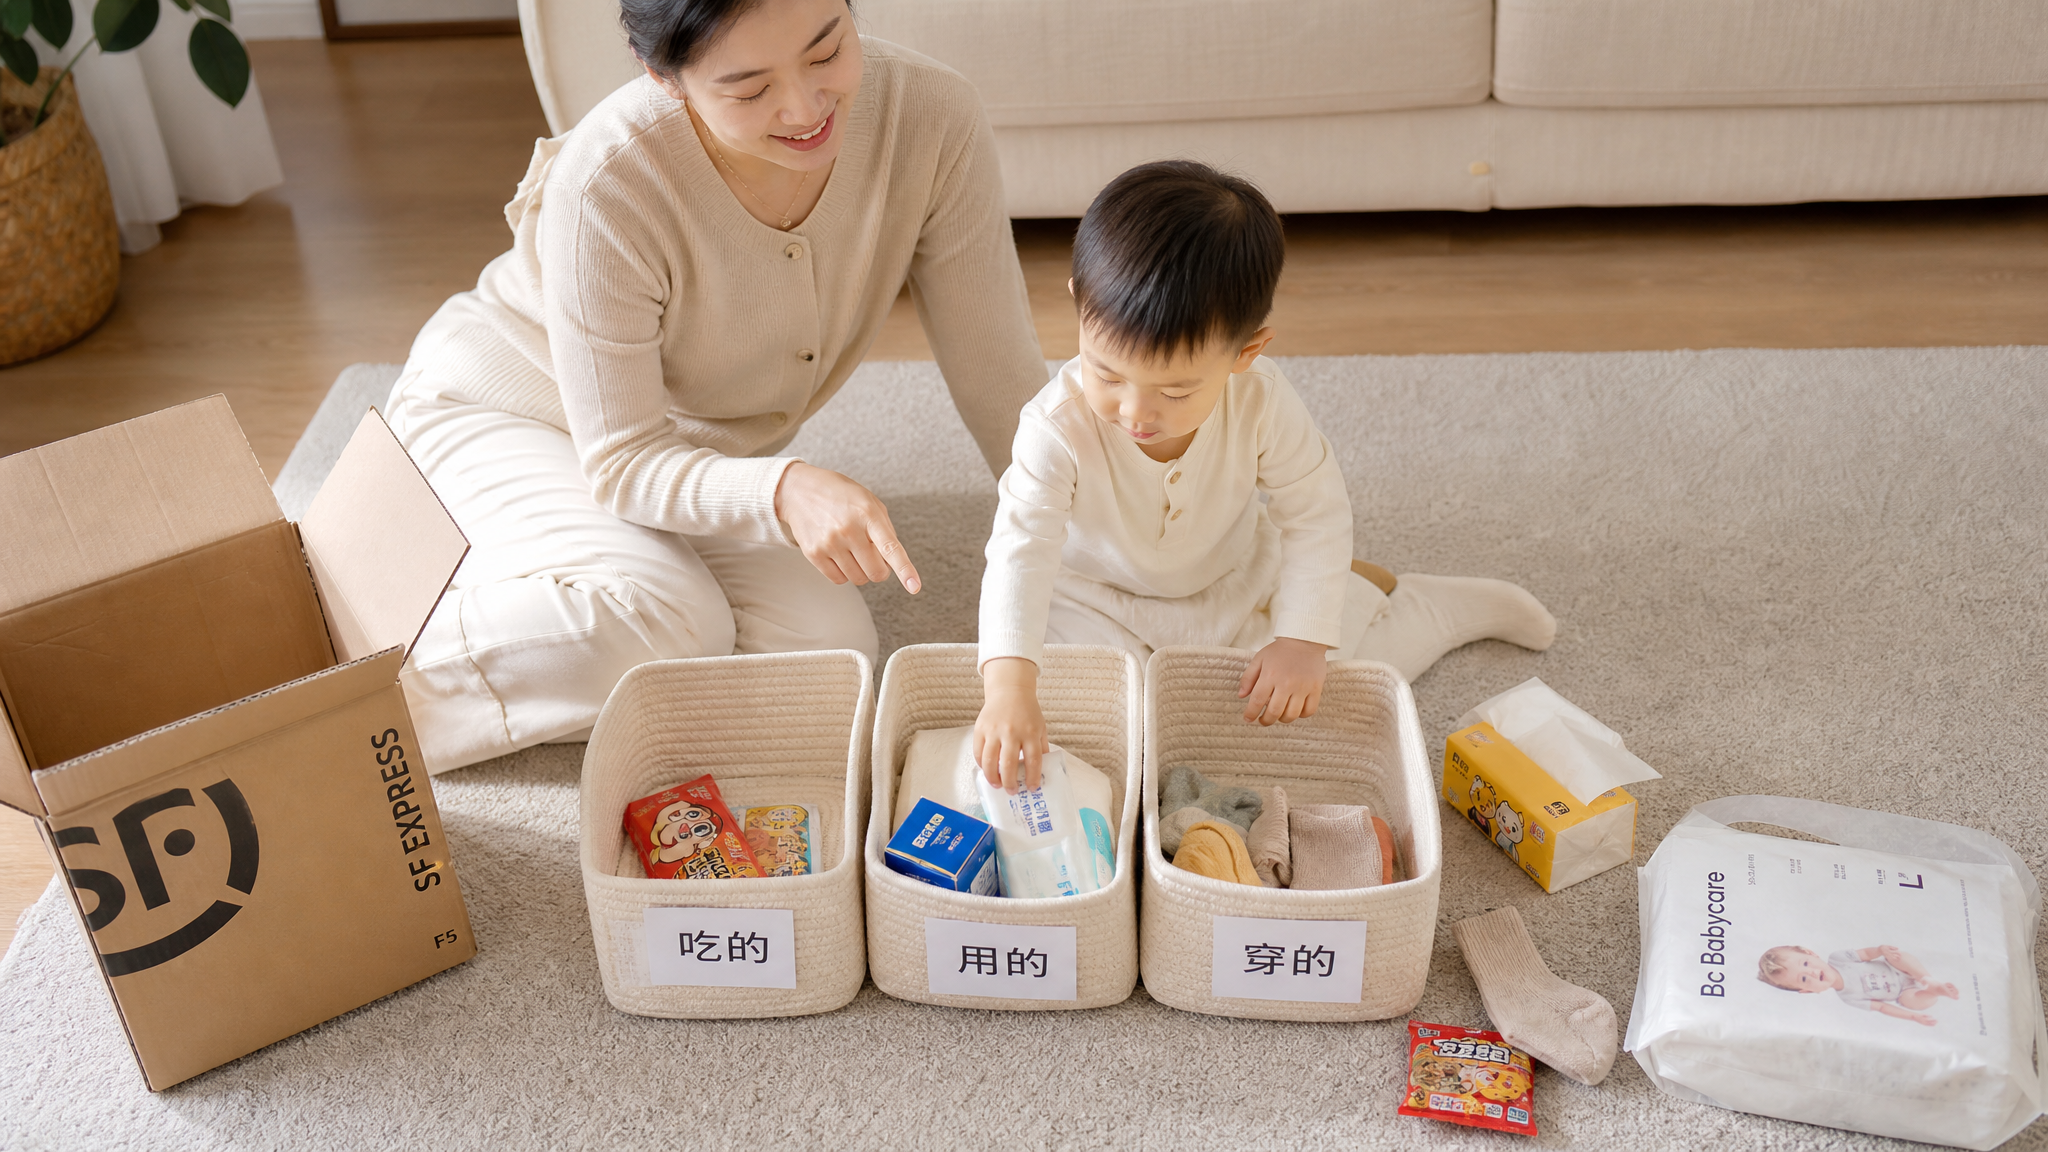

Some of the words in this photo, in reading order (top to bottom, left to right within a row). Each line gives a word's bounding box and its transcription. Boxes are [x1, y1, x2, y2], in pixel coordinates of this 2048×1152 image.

[371, 728, 430, 855] EXPRESS
[54, 788, 196, 932] SF
[408, 859, 441, 892] SF
[1898, 873, 1924, 890] L
[1700, 871, 1732, 966] Babycare
[433, 928, 458, 949] F5
[679, 929, 768, 964] 吃的
[958, 945, 1048, 978] 用的
[1243, 942, 1335, 977] 穿的
[1700, 971, 1725, 998] Bc
